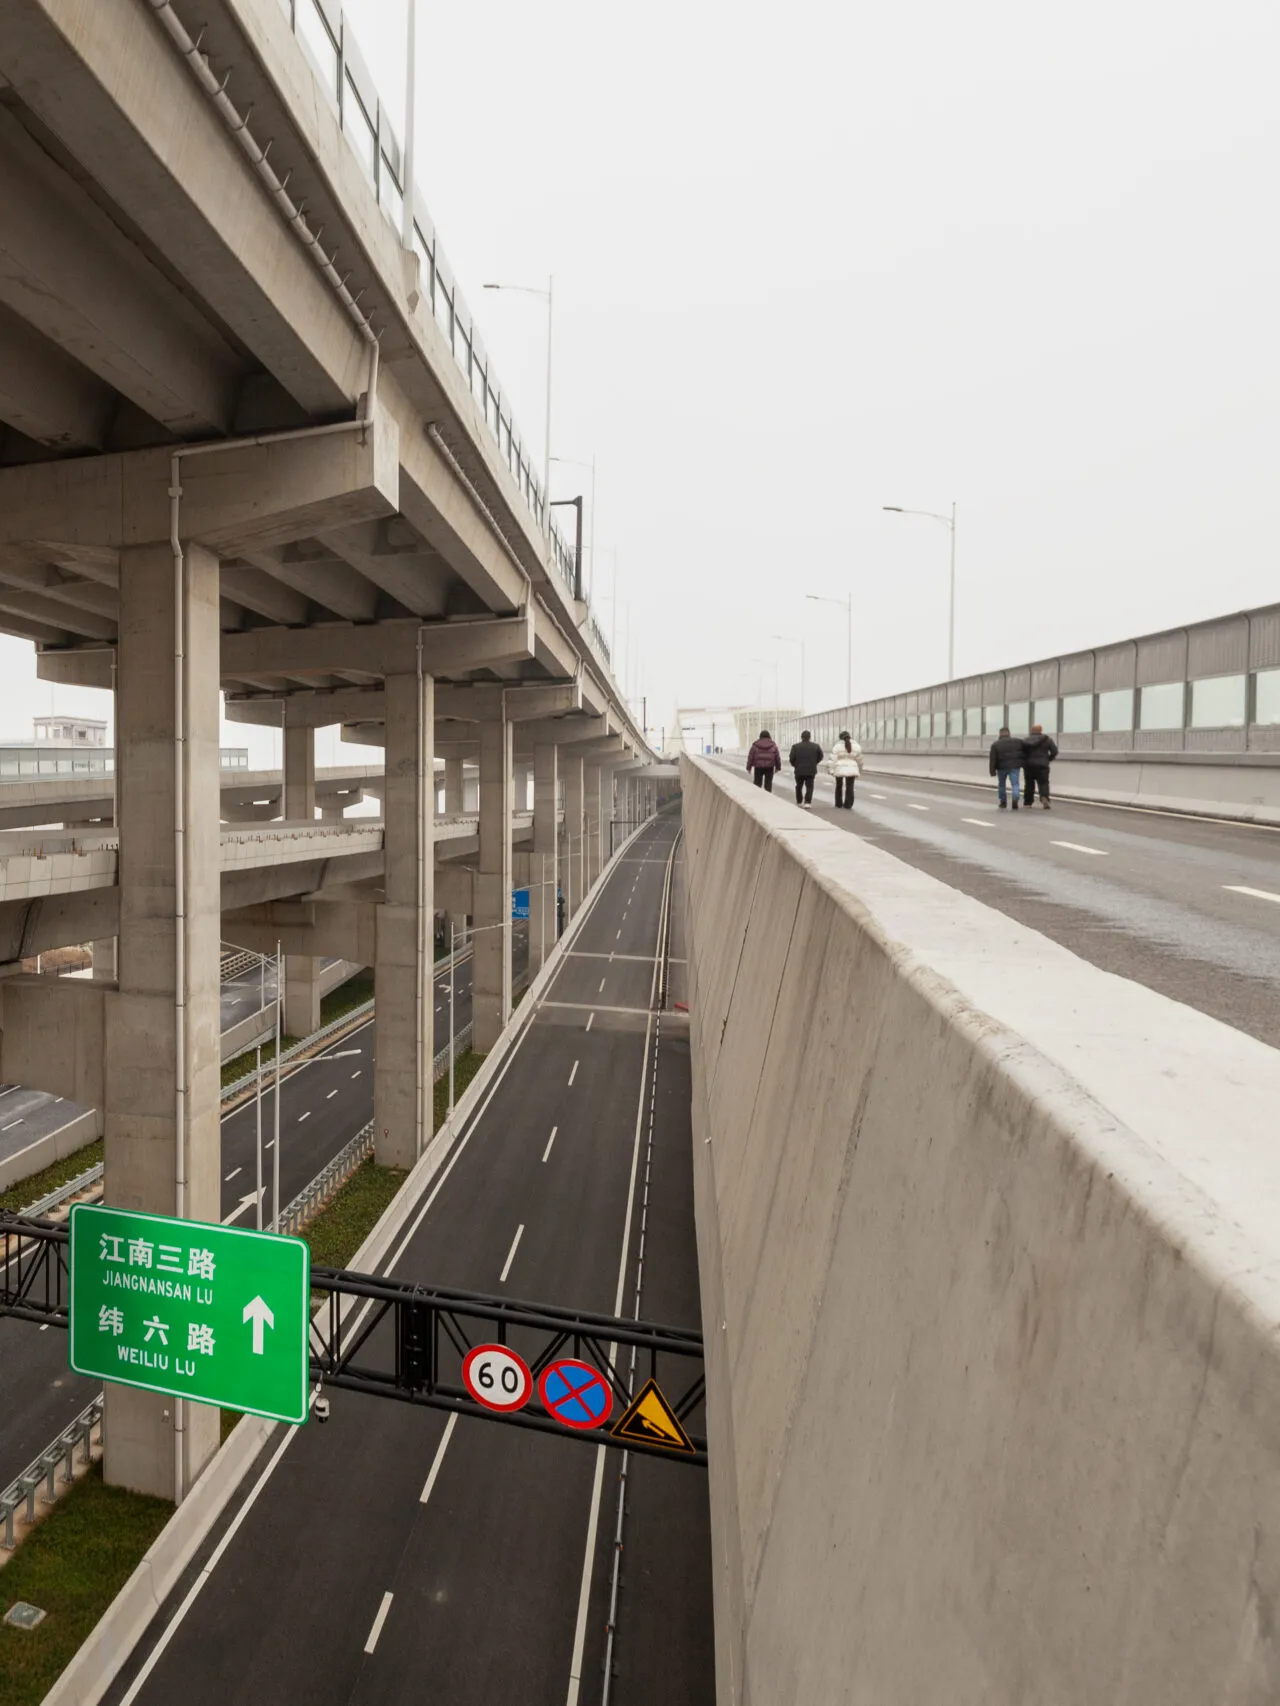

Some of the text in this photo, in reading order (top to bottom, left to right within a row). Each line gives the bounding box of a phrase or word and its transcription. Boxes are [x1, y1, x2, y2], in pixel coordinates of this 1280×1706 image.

[99, 1233, 216, 1281] 江南三路
[103, 1270, 213, 1305] JIANGNANSAN LU
[117, 1345, 196, 1376] WEILIU LU
[478, 1362, 519, 1394] 60
